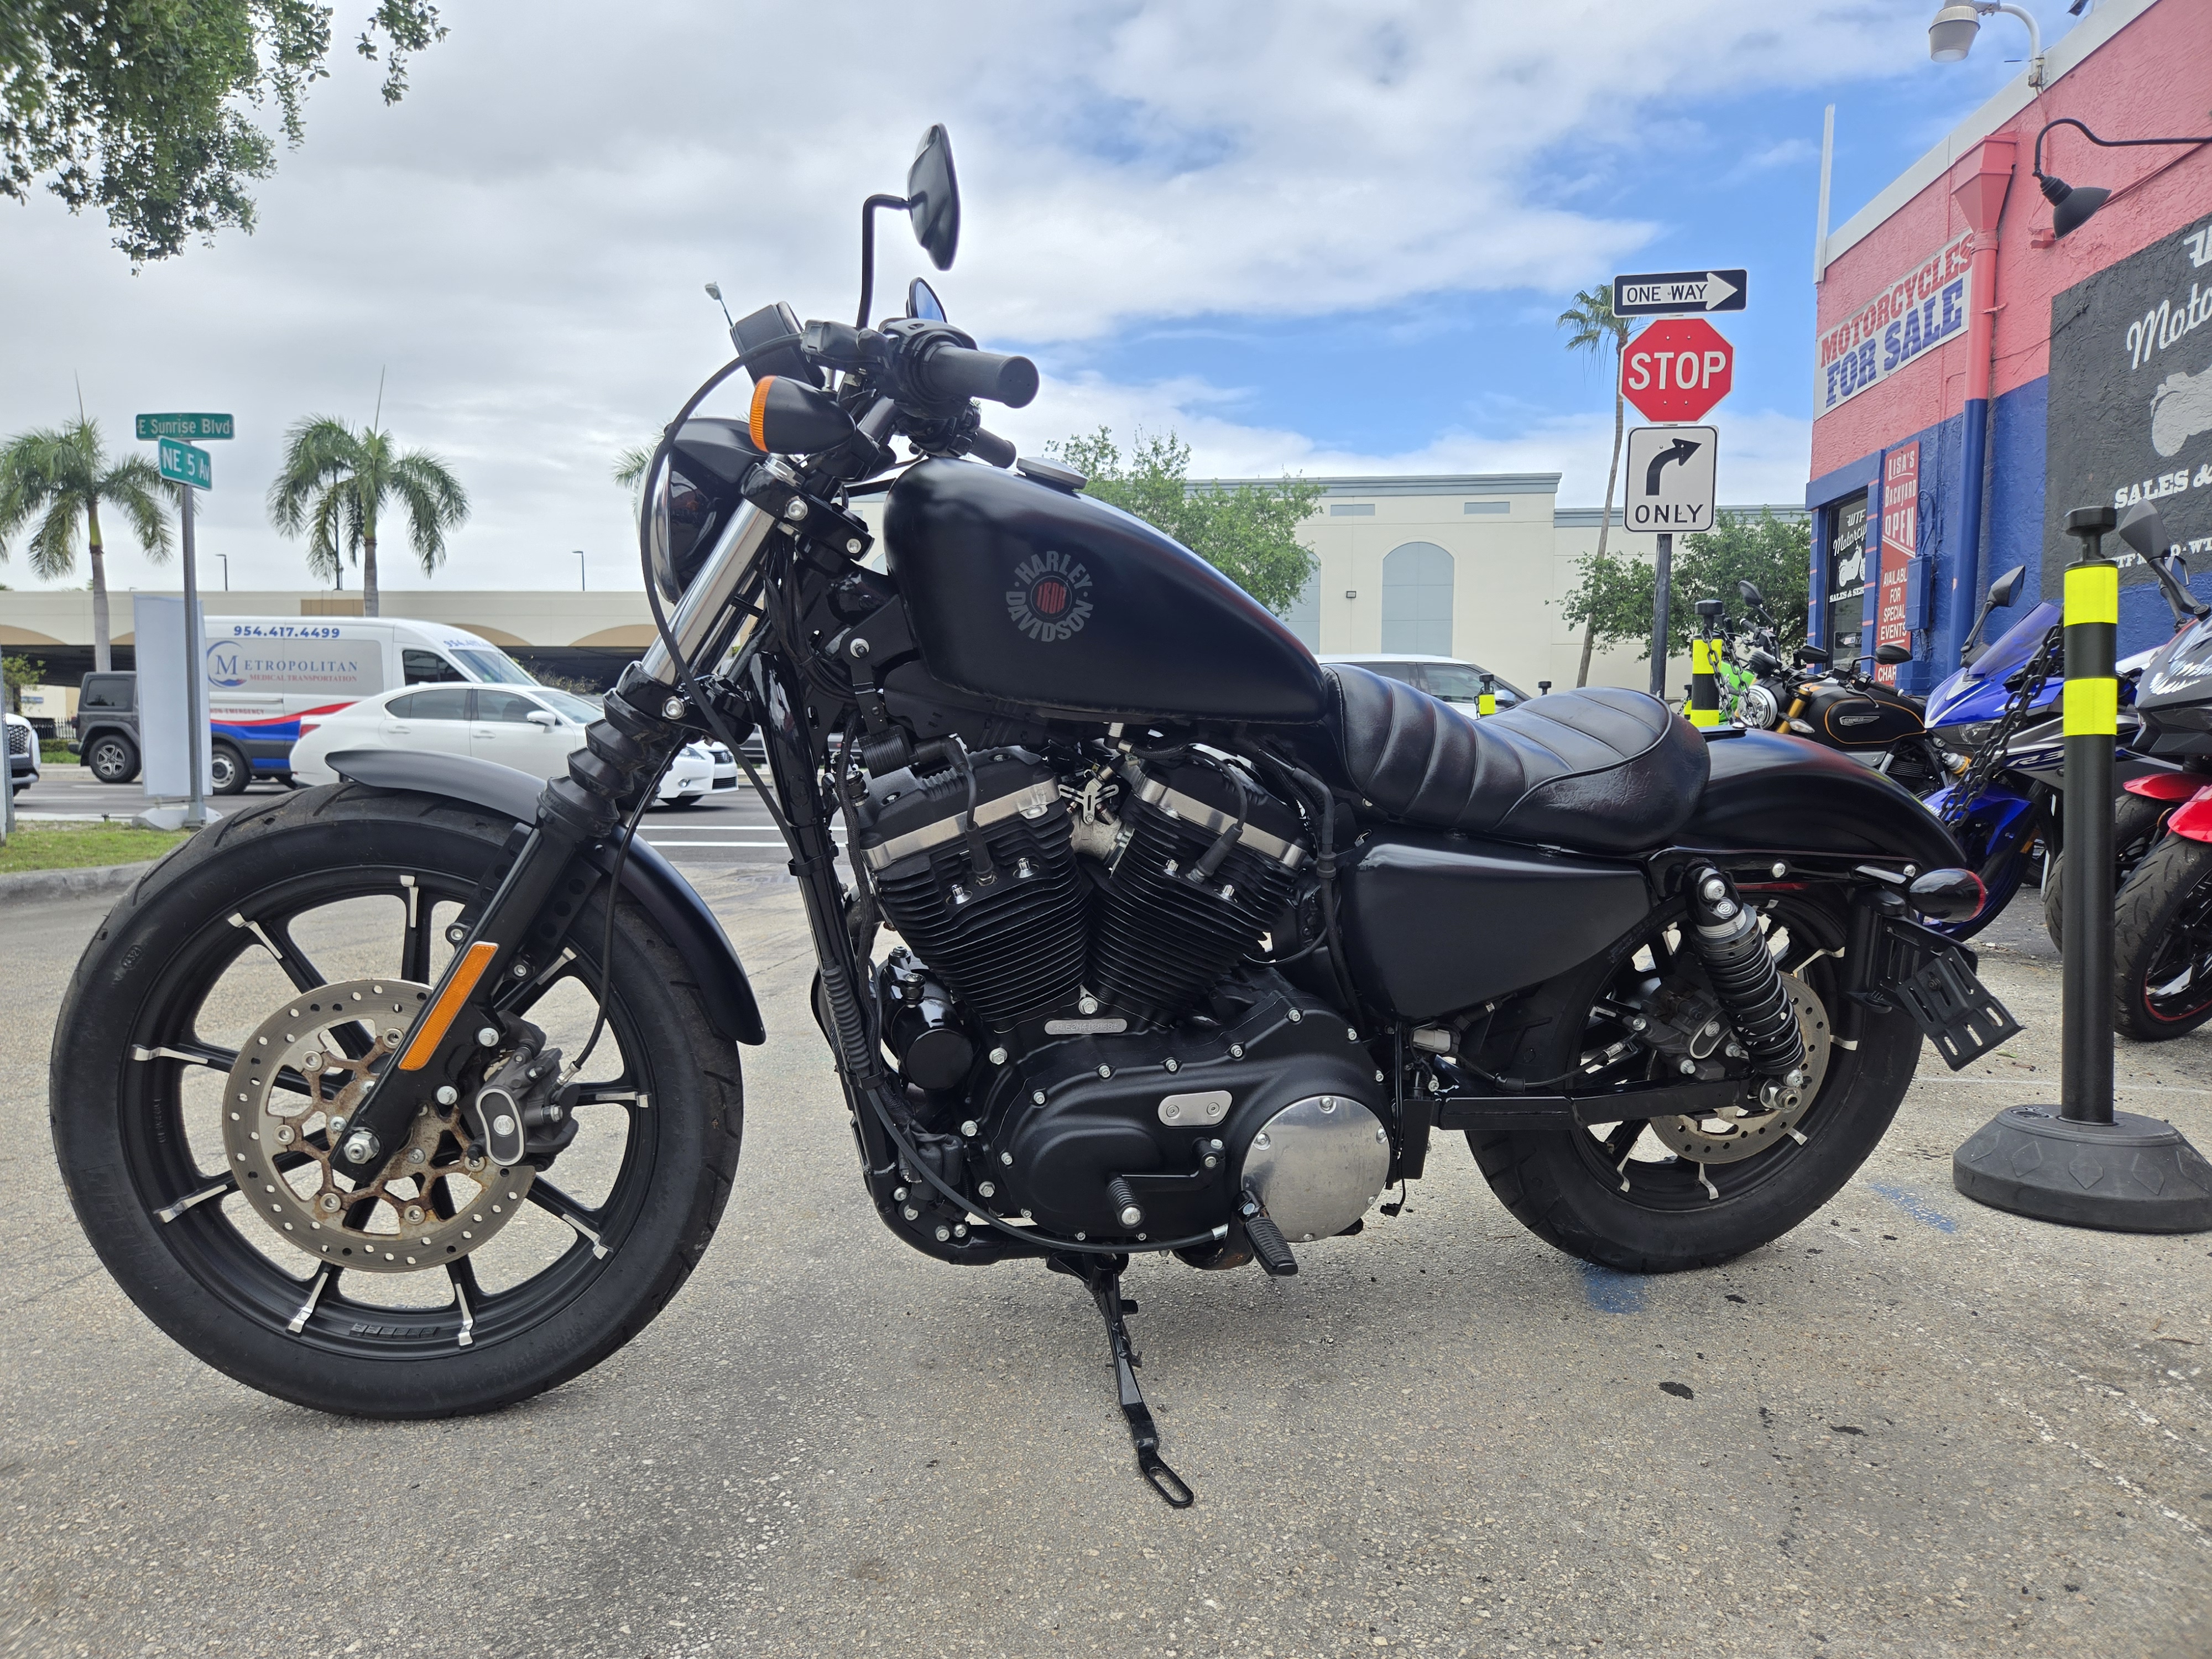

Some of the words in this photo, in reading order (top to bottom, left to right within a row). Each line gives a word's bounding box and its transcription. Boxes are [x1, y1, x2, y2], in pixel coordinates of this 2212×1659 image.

[1627, 286, 1661, 302] ONE
[1671, 284, 1708, 301] WAY
[1820, 233, 1975, 369] MOTORCYCLES
[1826, 338, 1877, 408] FOR
[1884, 278, 1963, 371] SALE
[1629, 351, 1726, 390] STOP
[138, 420, 146, 434] E
[150, 419, 196, 434] Sunrise
[202, 418, 230, 434] Blvd
[162, 447, 182, 473] NE
[187, 453, 195, 476] 5
[200, 458, 210, 482] Av
[1888, 450, 1915, 481] LISA'S
[2114, 469, 2189, 509] SALES
[1635, 504, 1704, 524] ONLY
[1846, 508, 1866, 527] WTF
[1885, 507, 1914, 548] OPEN
[1014, 551, 1093, 589] HARLEY
[1829, 591, 1847, 603] SALES
[1890, 587, 1901, 604] FOR
[1006, 591, 1093, 642] DAVIDSON
[1884, 604, 1906, 623] SPECIAL
[234, 626, 340, 638] 954.417.4499
[1880, 622, 1907, 640] EVENTS
[215, 655, 357, 675] METROPOLITAN
[2006, 749, 2065, 767] R3
